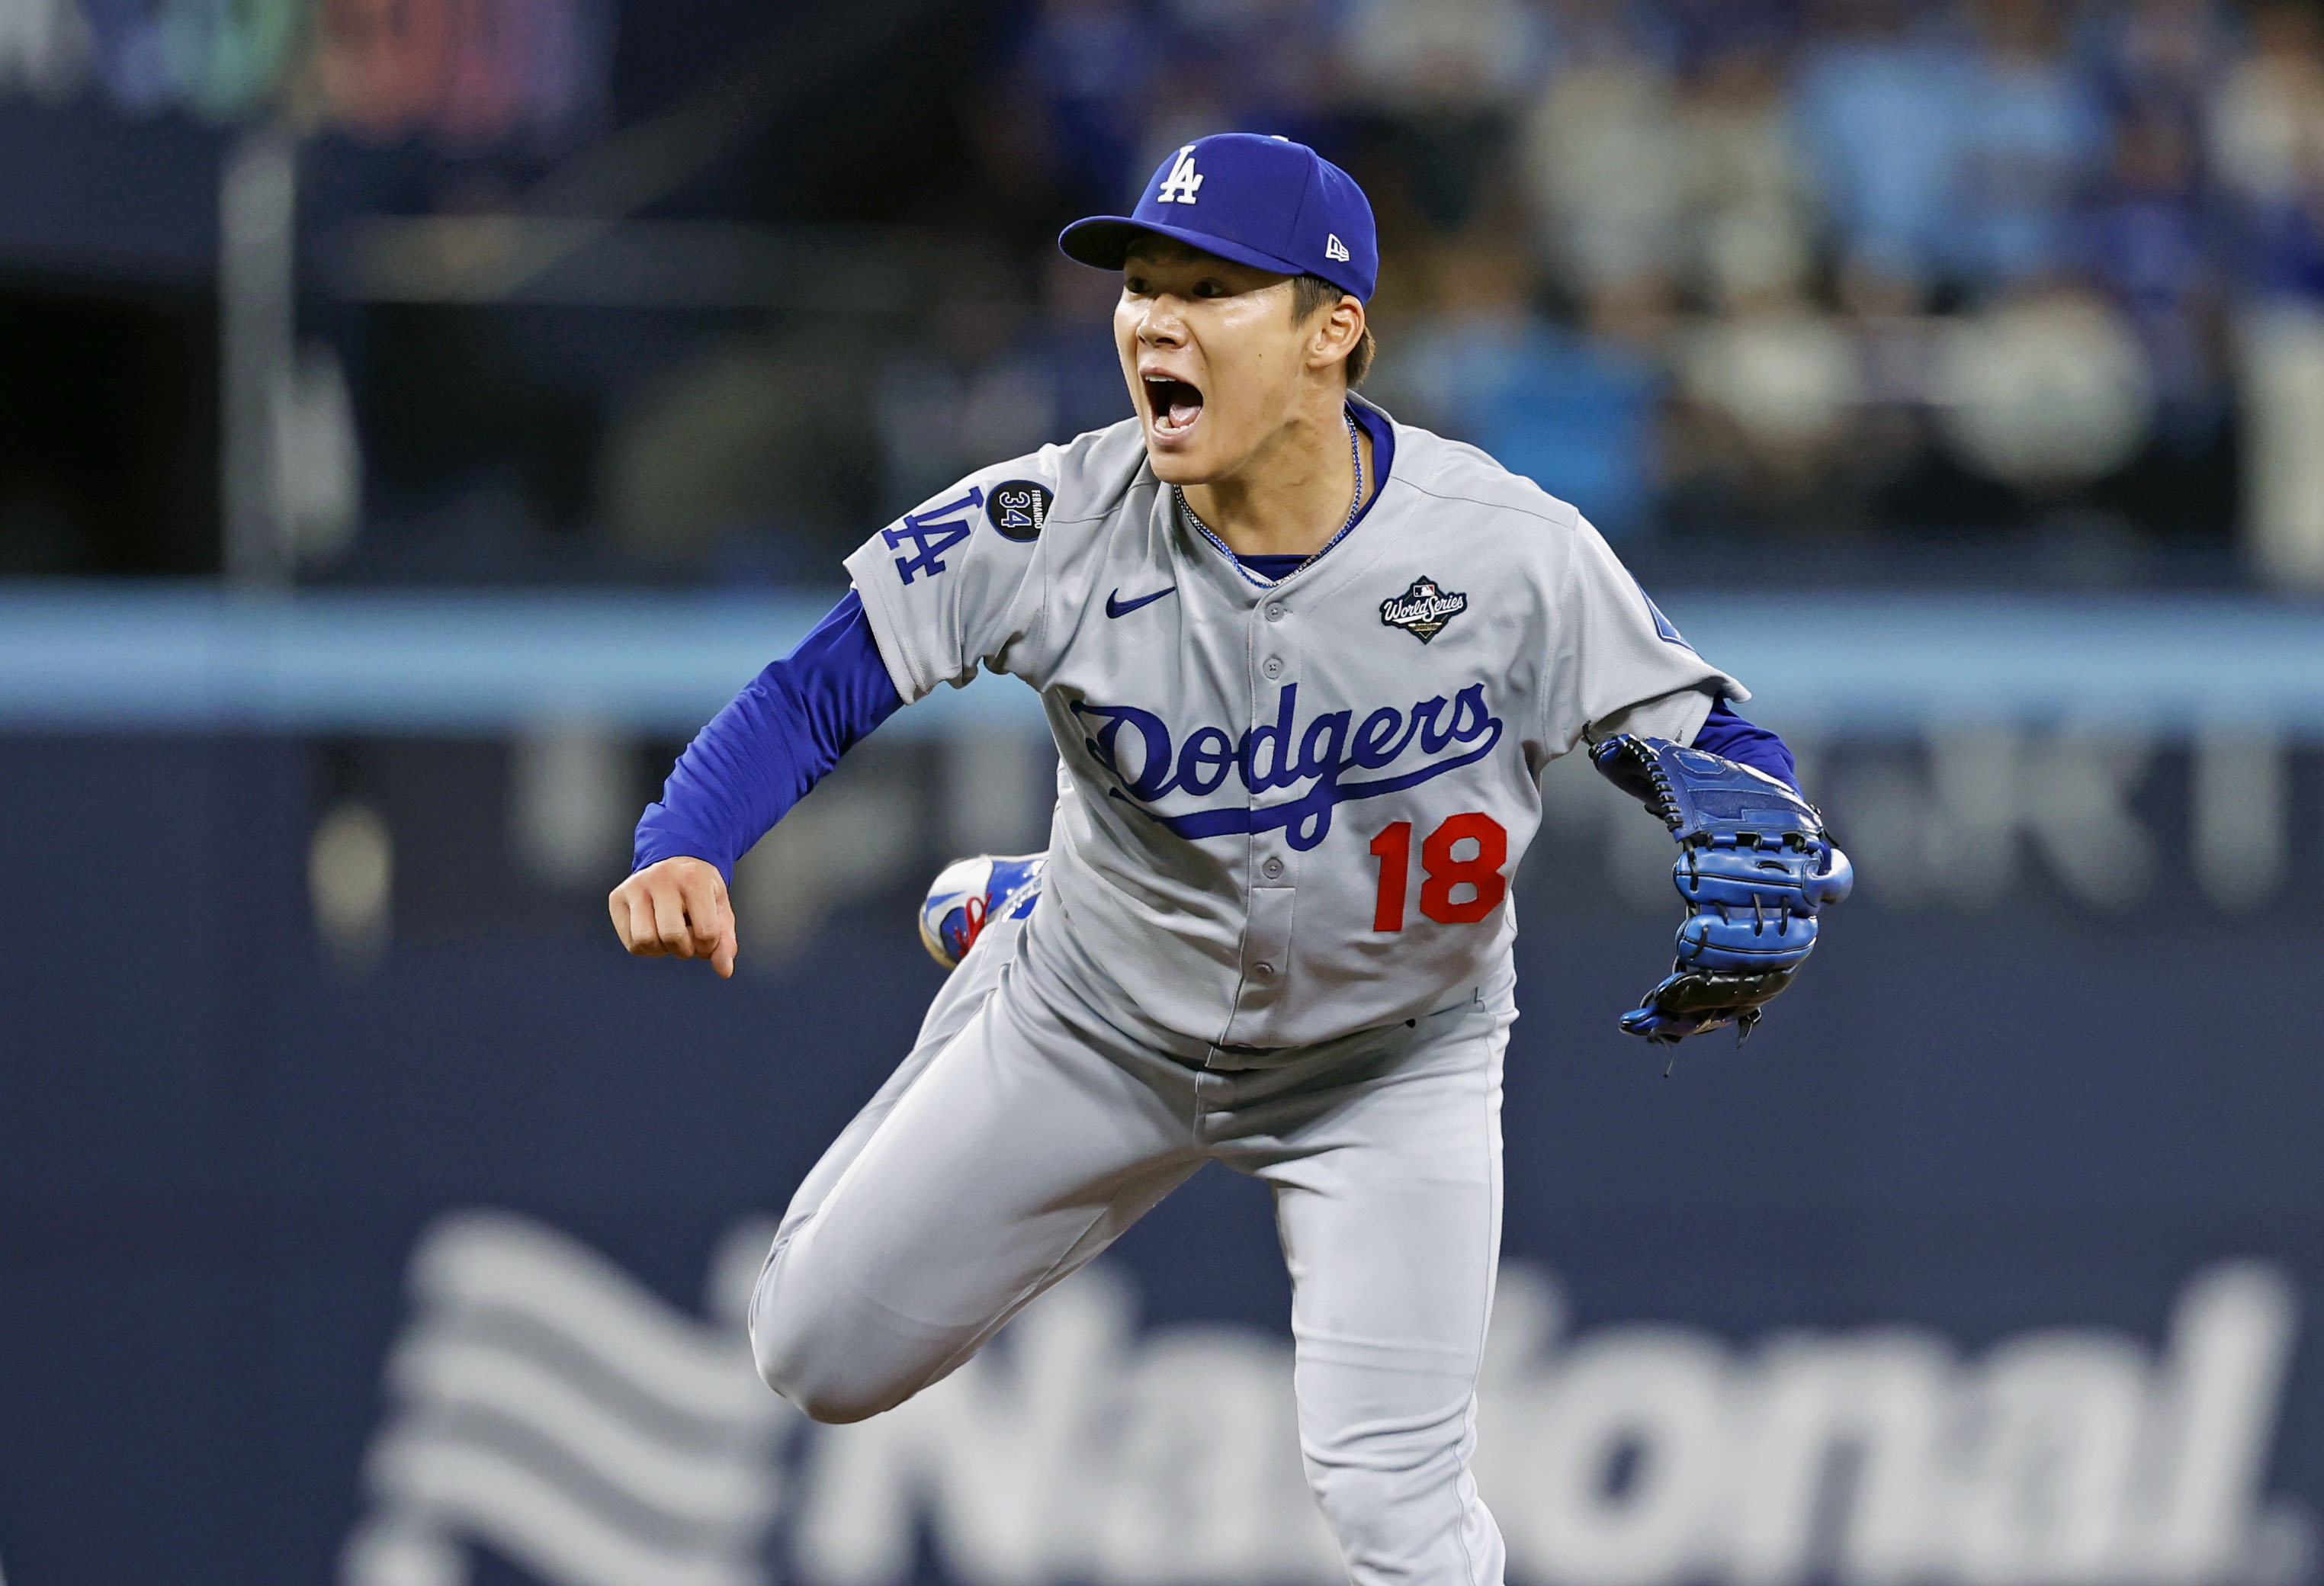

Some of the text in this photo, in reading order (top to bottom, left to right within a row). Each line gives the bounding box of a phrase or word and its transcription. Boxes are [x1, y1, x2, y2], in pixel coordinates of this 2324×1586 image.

[1157, 145, 1203, 204] LA
[881, 486, 984, 586] LA
[999, 491, 1032, 528] 34
[1031, 490, 1044, 529] FERNANDO
[1383, 596, 1464, 623] World Series
[1070, 682, 1503, 852] Dodgers
[1370, 812, 1507, 932] 18
